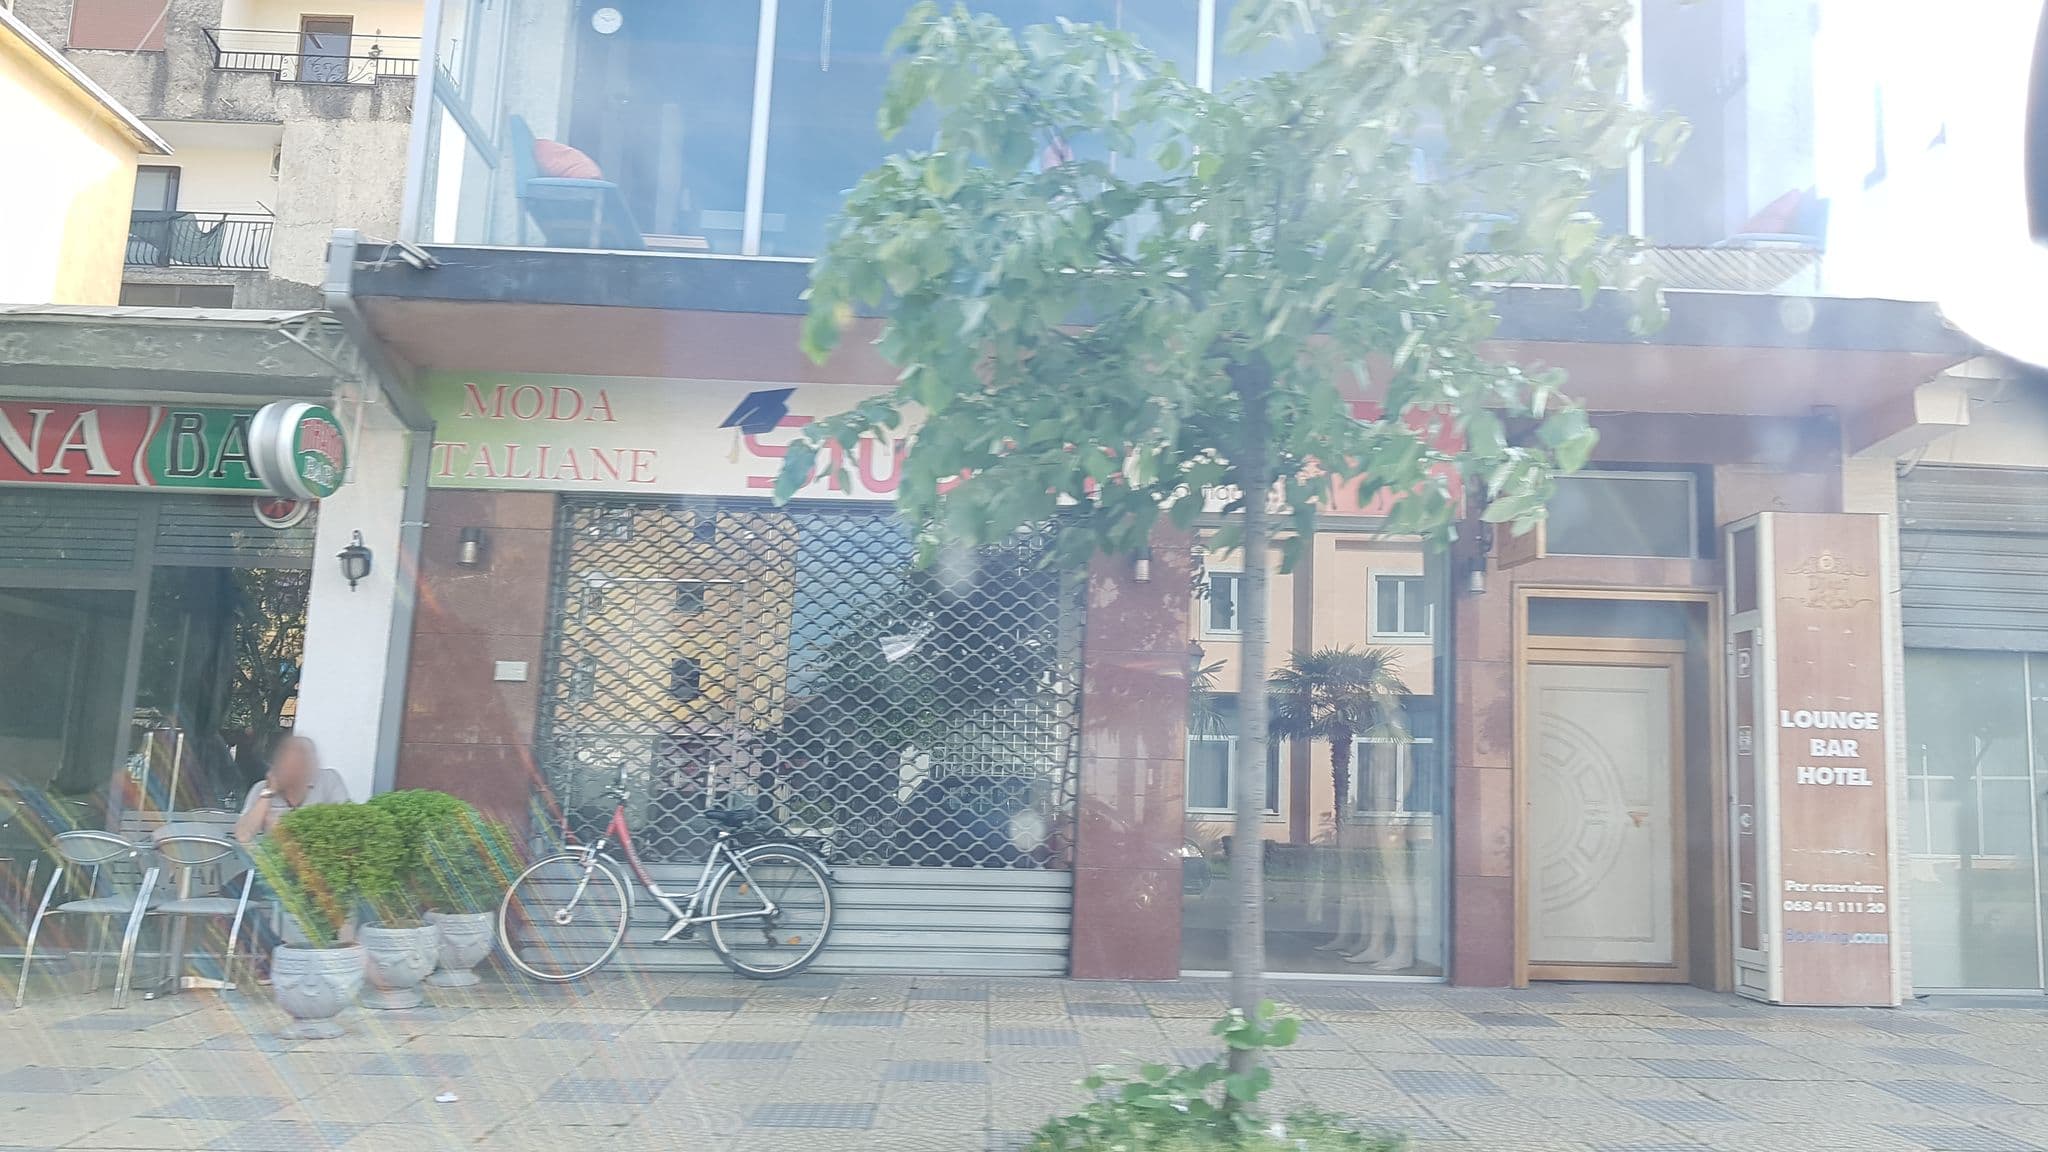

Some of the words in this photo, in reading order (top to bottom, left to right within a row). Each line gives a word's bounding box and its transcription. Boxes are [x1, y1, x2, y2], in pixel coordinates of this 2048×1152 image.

[460, 382, 617, 422] MODA
[163, 411, 263, 481] BA
[431, 441, 658, 484] TALIANE
[1779, 709, 1880, 731] LOUNGE
[1809, 738, 1861, 758] BAR
[1796, 766, 1873, 786] HOTEL
[1814, 901, 1833, 913] 41
[1837, 901, 1864, 914] 111
[1865, 902, 1887, 914] 20
